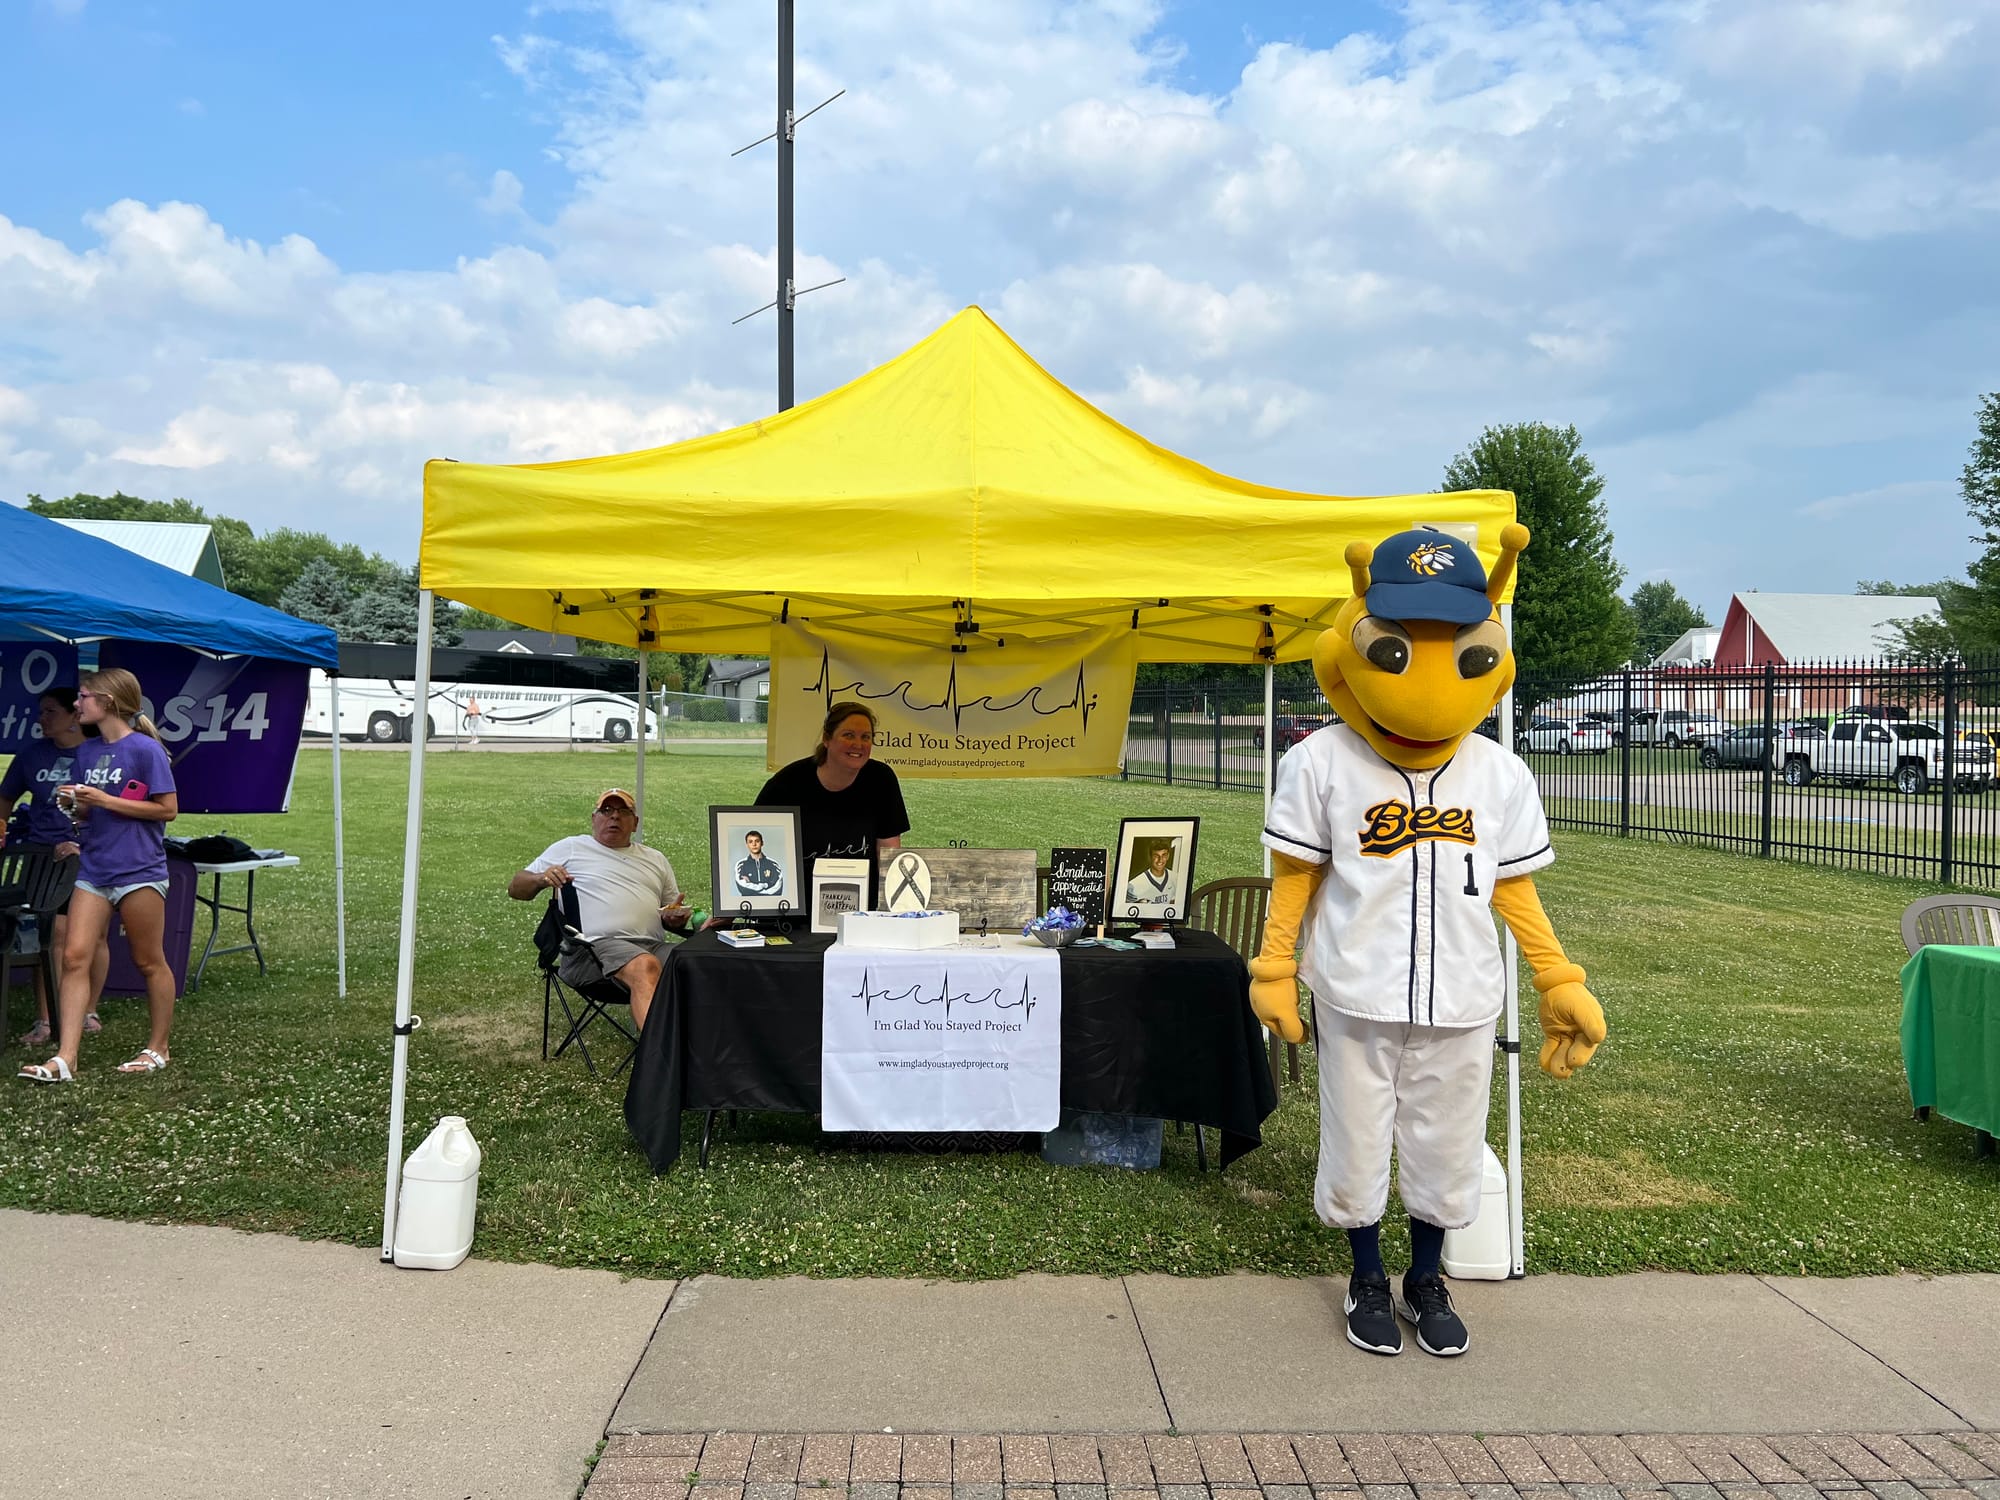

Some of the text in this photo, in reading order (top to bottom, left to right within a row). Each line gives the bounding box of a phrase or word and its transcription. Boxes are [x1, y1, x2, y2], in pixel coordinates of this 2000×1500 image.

[872, 731, 1076, 755] Glad You Stayed Project
[883, 756, 1025, 768] www.imgladyoustayedproject.org
[1360, 799, 1477, 857] Bees
[1050, 861, 1106, 879] donations
[1463, 852, 1479, 896] 1
[874, 1019, 1022, 1034] I'm Glad You Stayed Project
[878, 1059, 1009, 1071] www.imgladyoustayedproject.org
